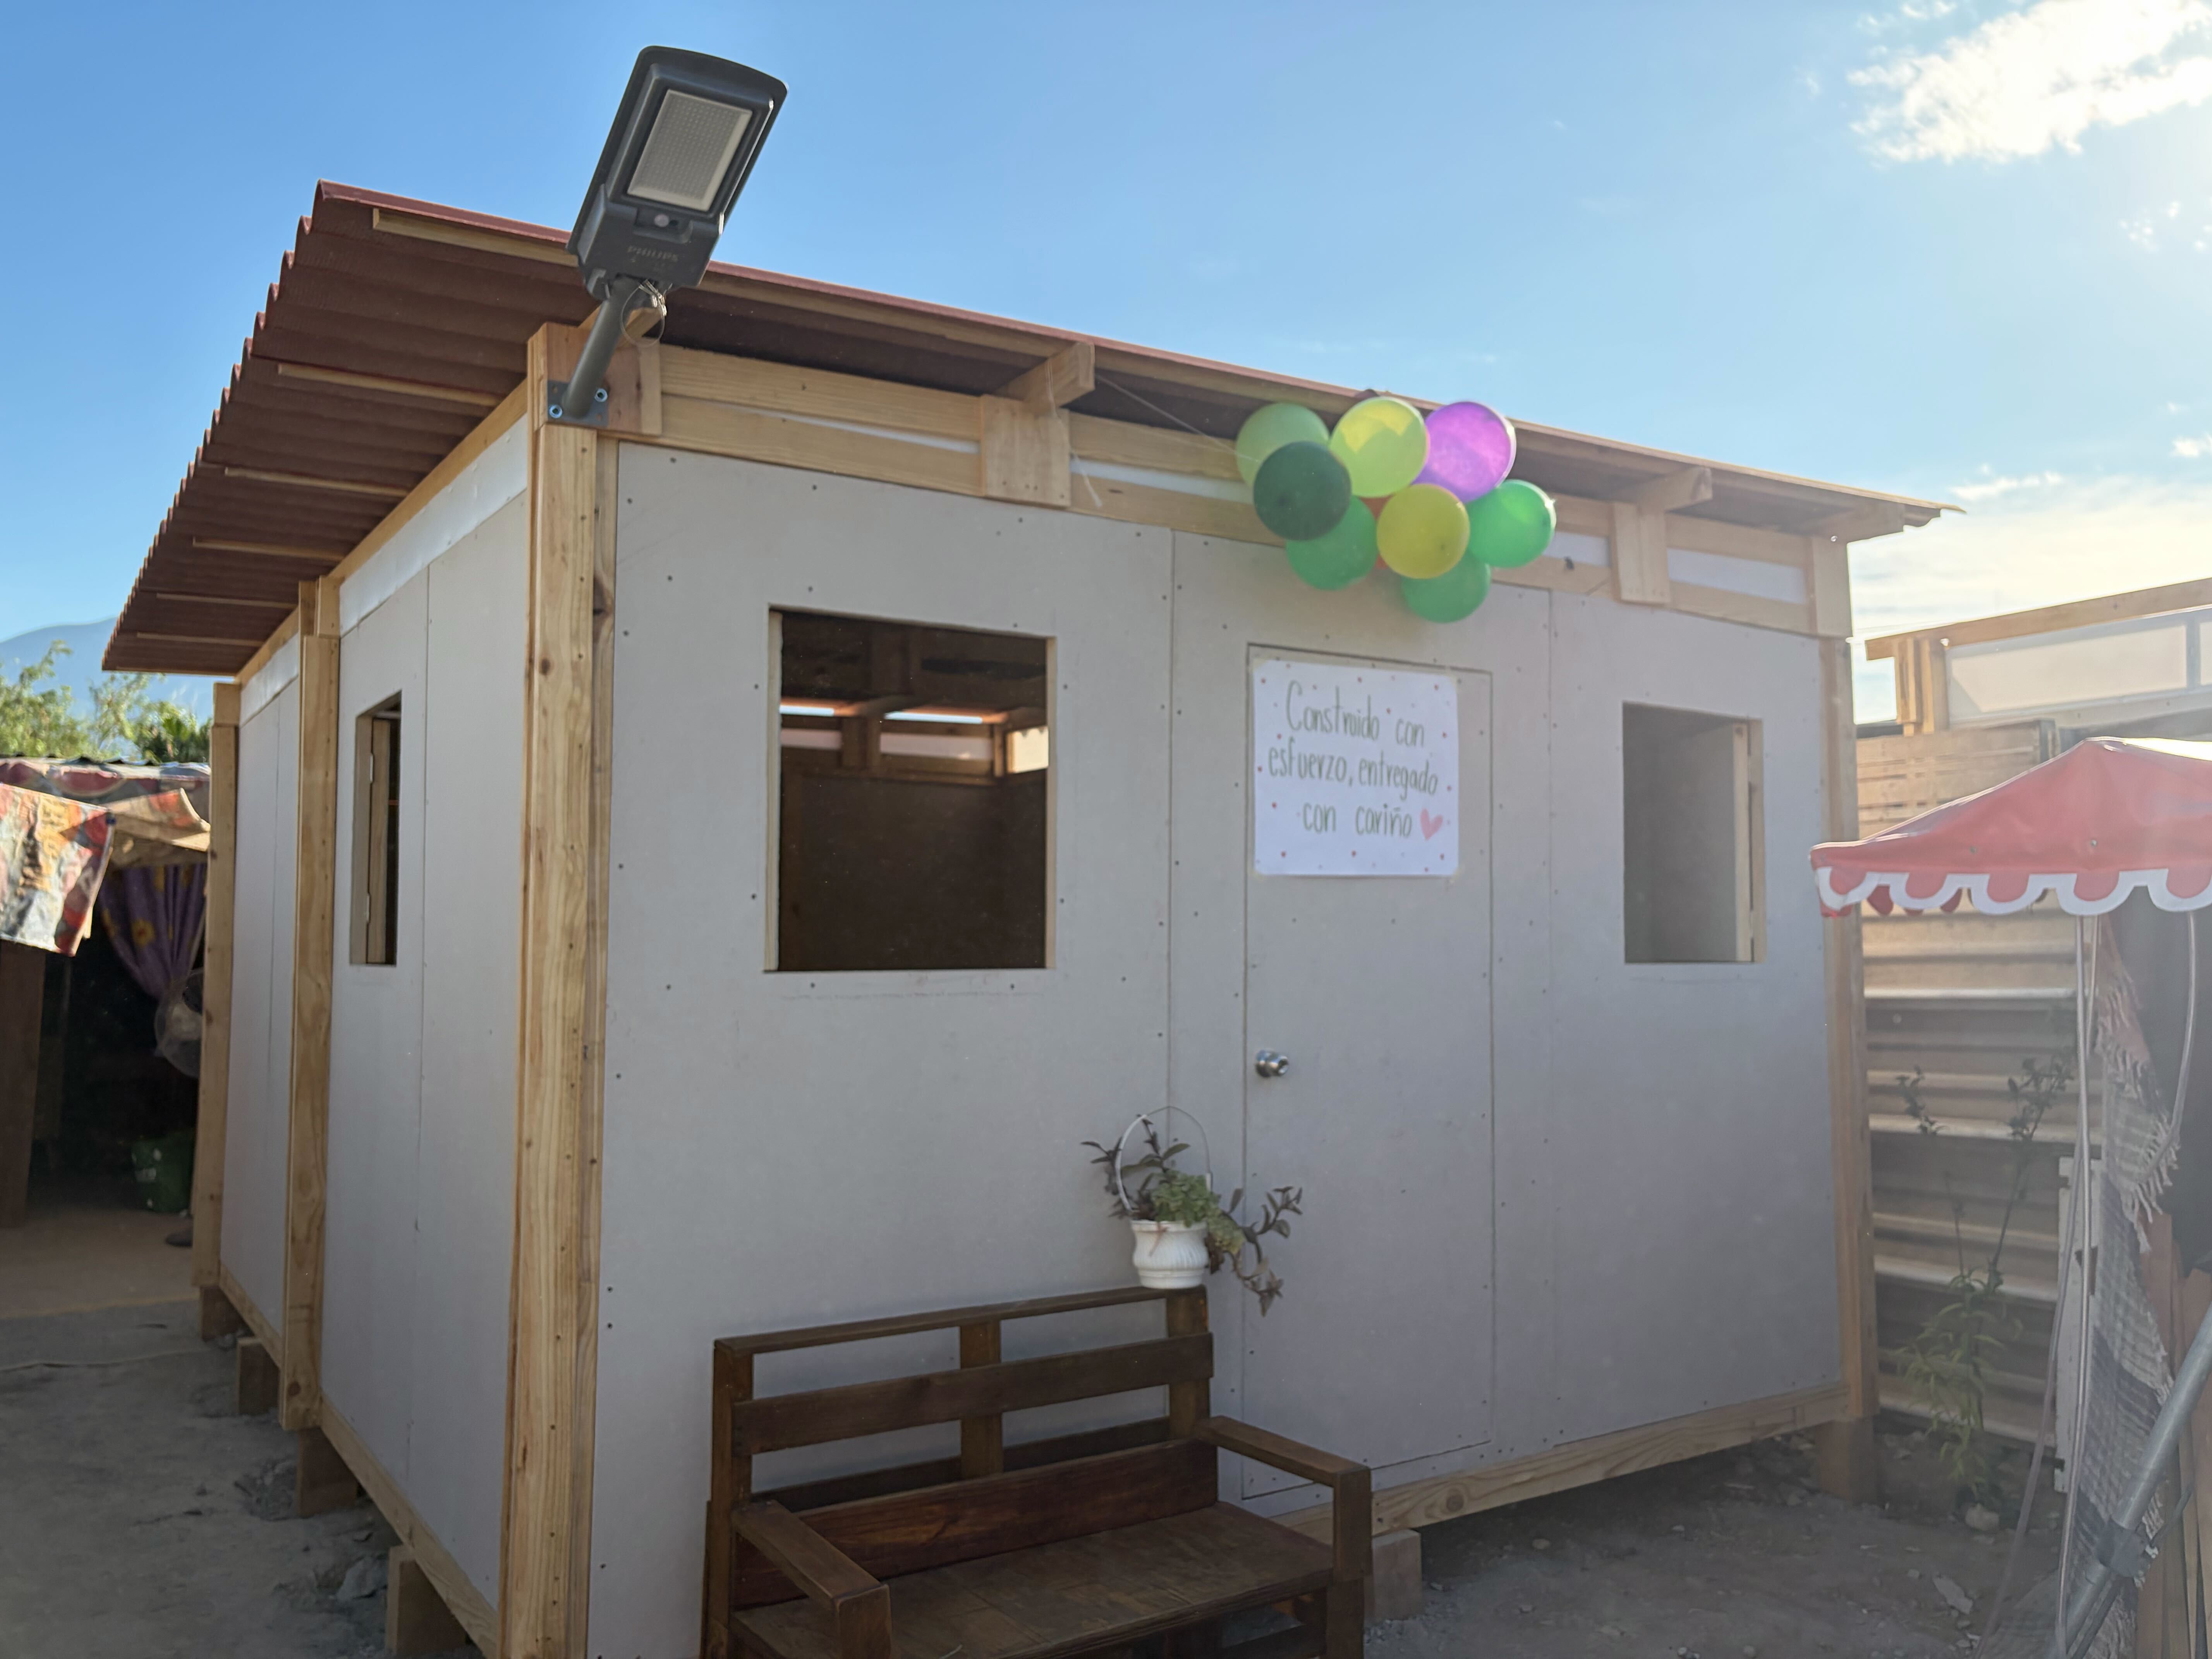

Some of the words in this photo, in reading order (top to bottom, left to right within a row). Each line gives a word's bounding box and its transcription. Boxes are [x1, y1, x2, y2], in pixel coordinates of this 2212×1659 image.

[1286, 680, 1380, 741] Construido
[1395, 718, 1425, 747] con
[1268, 736, 1353, 787] esfuerzo,
[1358, 749, 1438, 801] entregado
[1302, 802, 1337, 833] con
[1355, 803, 1413, 838] cariño
